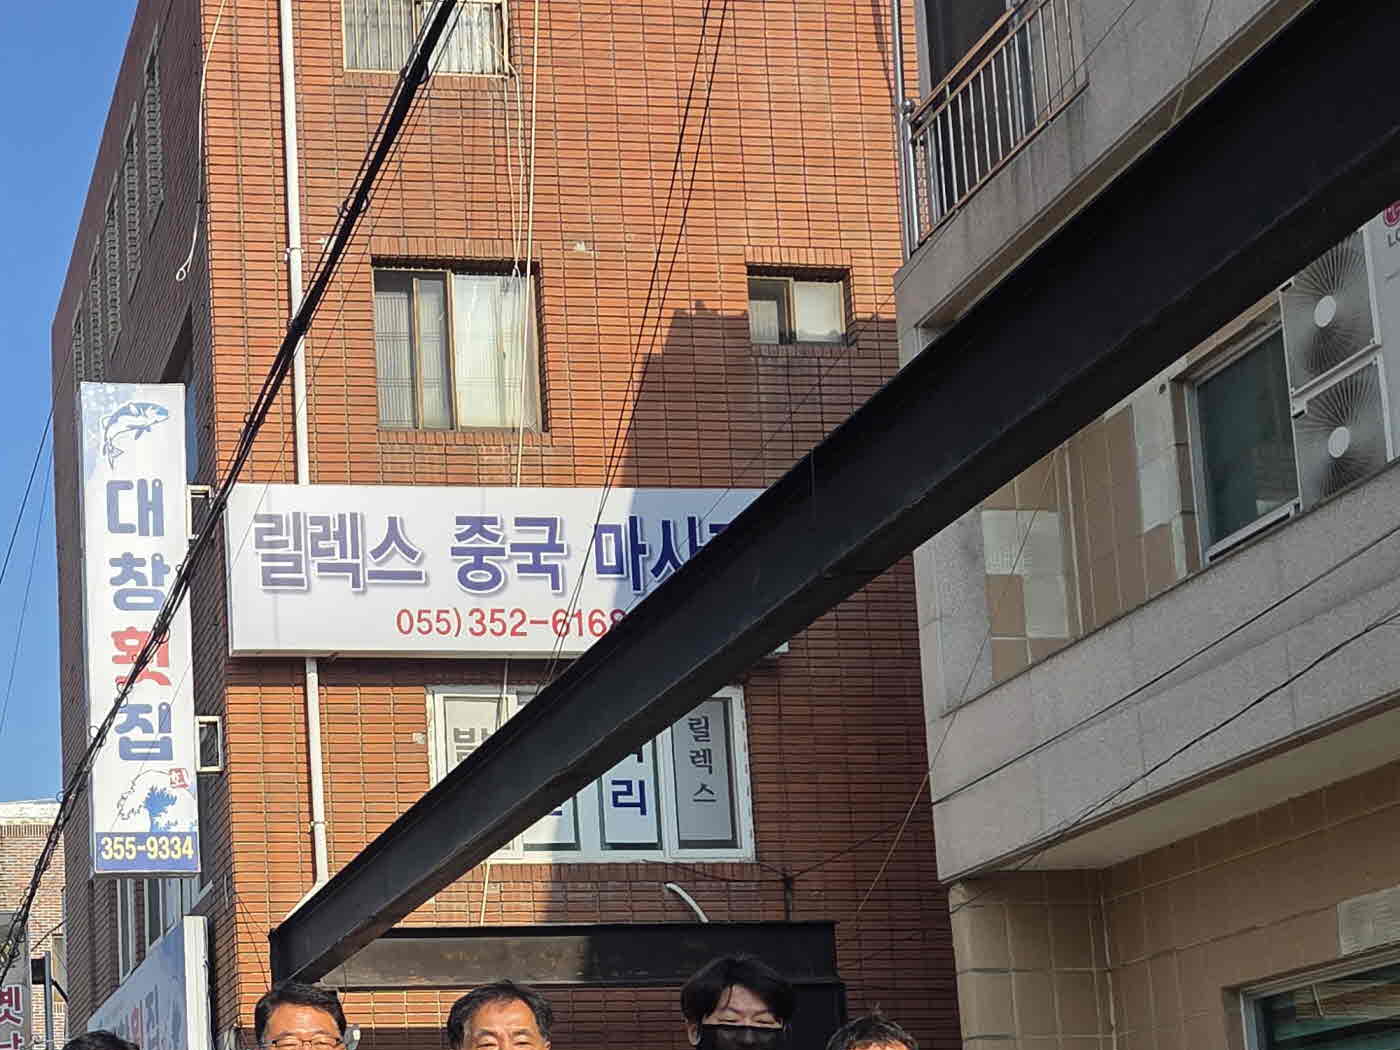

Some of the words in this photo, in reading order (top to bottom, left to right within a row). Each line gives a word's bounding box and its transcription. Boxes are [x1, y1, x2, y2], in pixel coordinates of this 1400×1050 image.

[253, 511, 425, 590] 릴렉스
[450, 514, 566, 592] 중국
[593, 514, 729, 592] 마사
[106, 479, 173, 761] 대창횟집
[688, 716, 717, 803] 릴렉스
[100, 835, 194, 861] 355-9334
